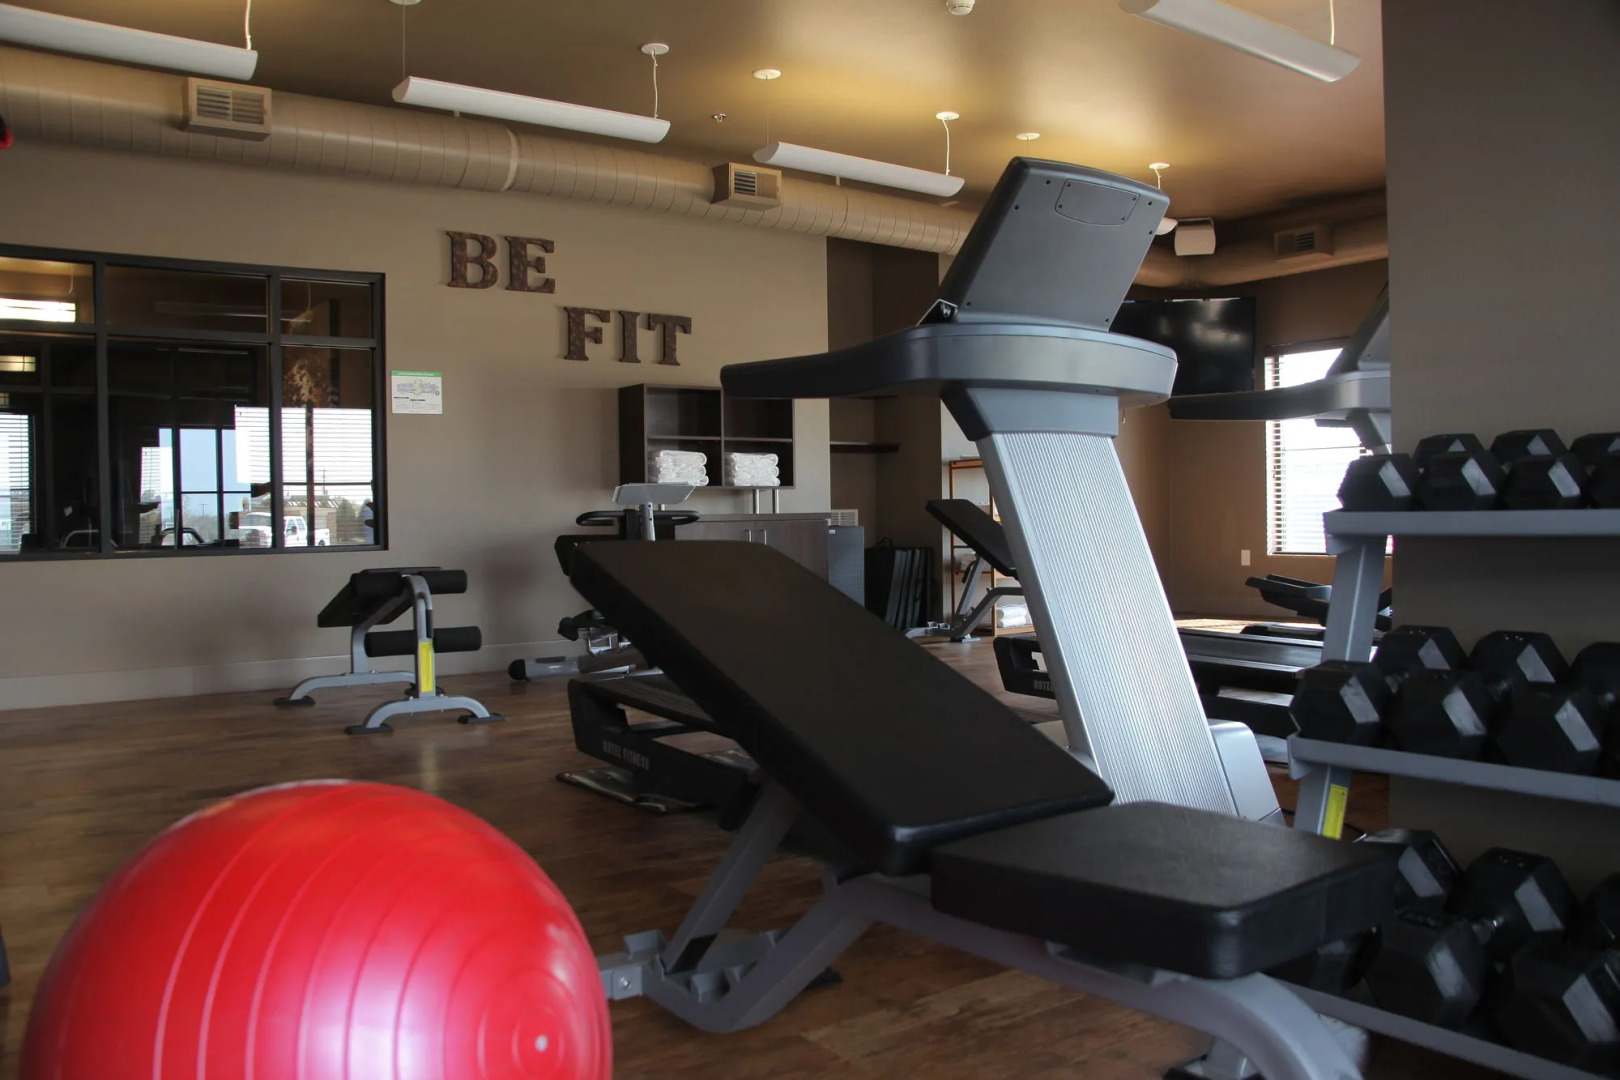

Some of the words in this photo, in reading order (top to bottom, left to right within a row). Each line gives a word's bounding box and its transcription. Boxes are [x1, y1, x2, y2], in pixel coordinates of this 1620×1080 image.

[446, 230, 555, 294] BE
[563, 306, 692, 366] FIT
[623, 748, 650, 770] FITNESS
